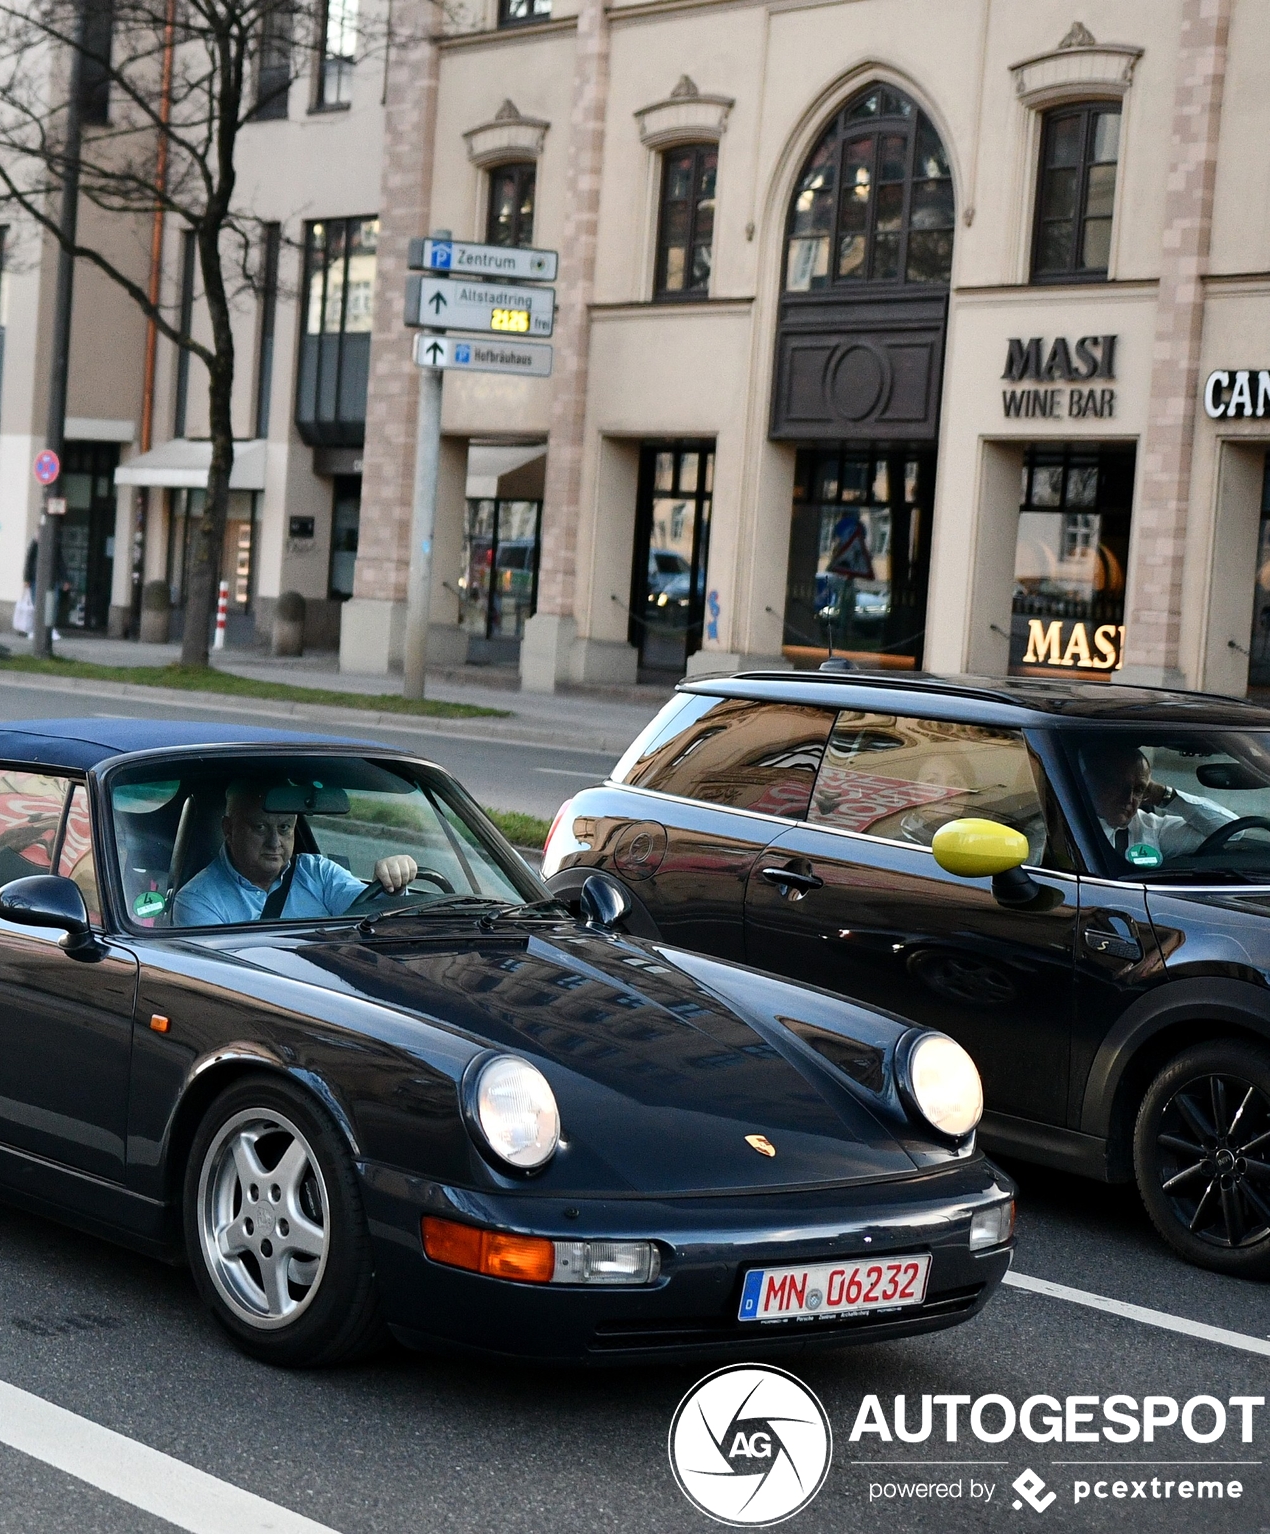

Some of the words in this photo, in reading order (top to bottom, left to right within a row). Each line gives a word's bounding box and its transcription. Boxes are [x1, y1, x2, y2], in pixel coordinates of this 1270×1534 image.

[458, 249, 516, 269] Zentrum
[460, 288, 533, 309] Altstadtring
[534, 316, 550, 331] frei
[474, 346, 533, 366] Hofbräuhaus
[1001, 334, 1118, 382] MASI
[1002, 389, 1062, 420] WINE
[1068, 388, 1116, 419] BAR
[143, 893, 153, 904] 4
[745, 1299, 753, 1311] D
[763, 1273, 808, 1312] MN
[826, 1262, 920, 1306] 06232
